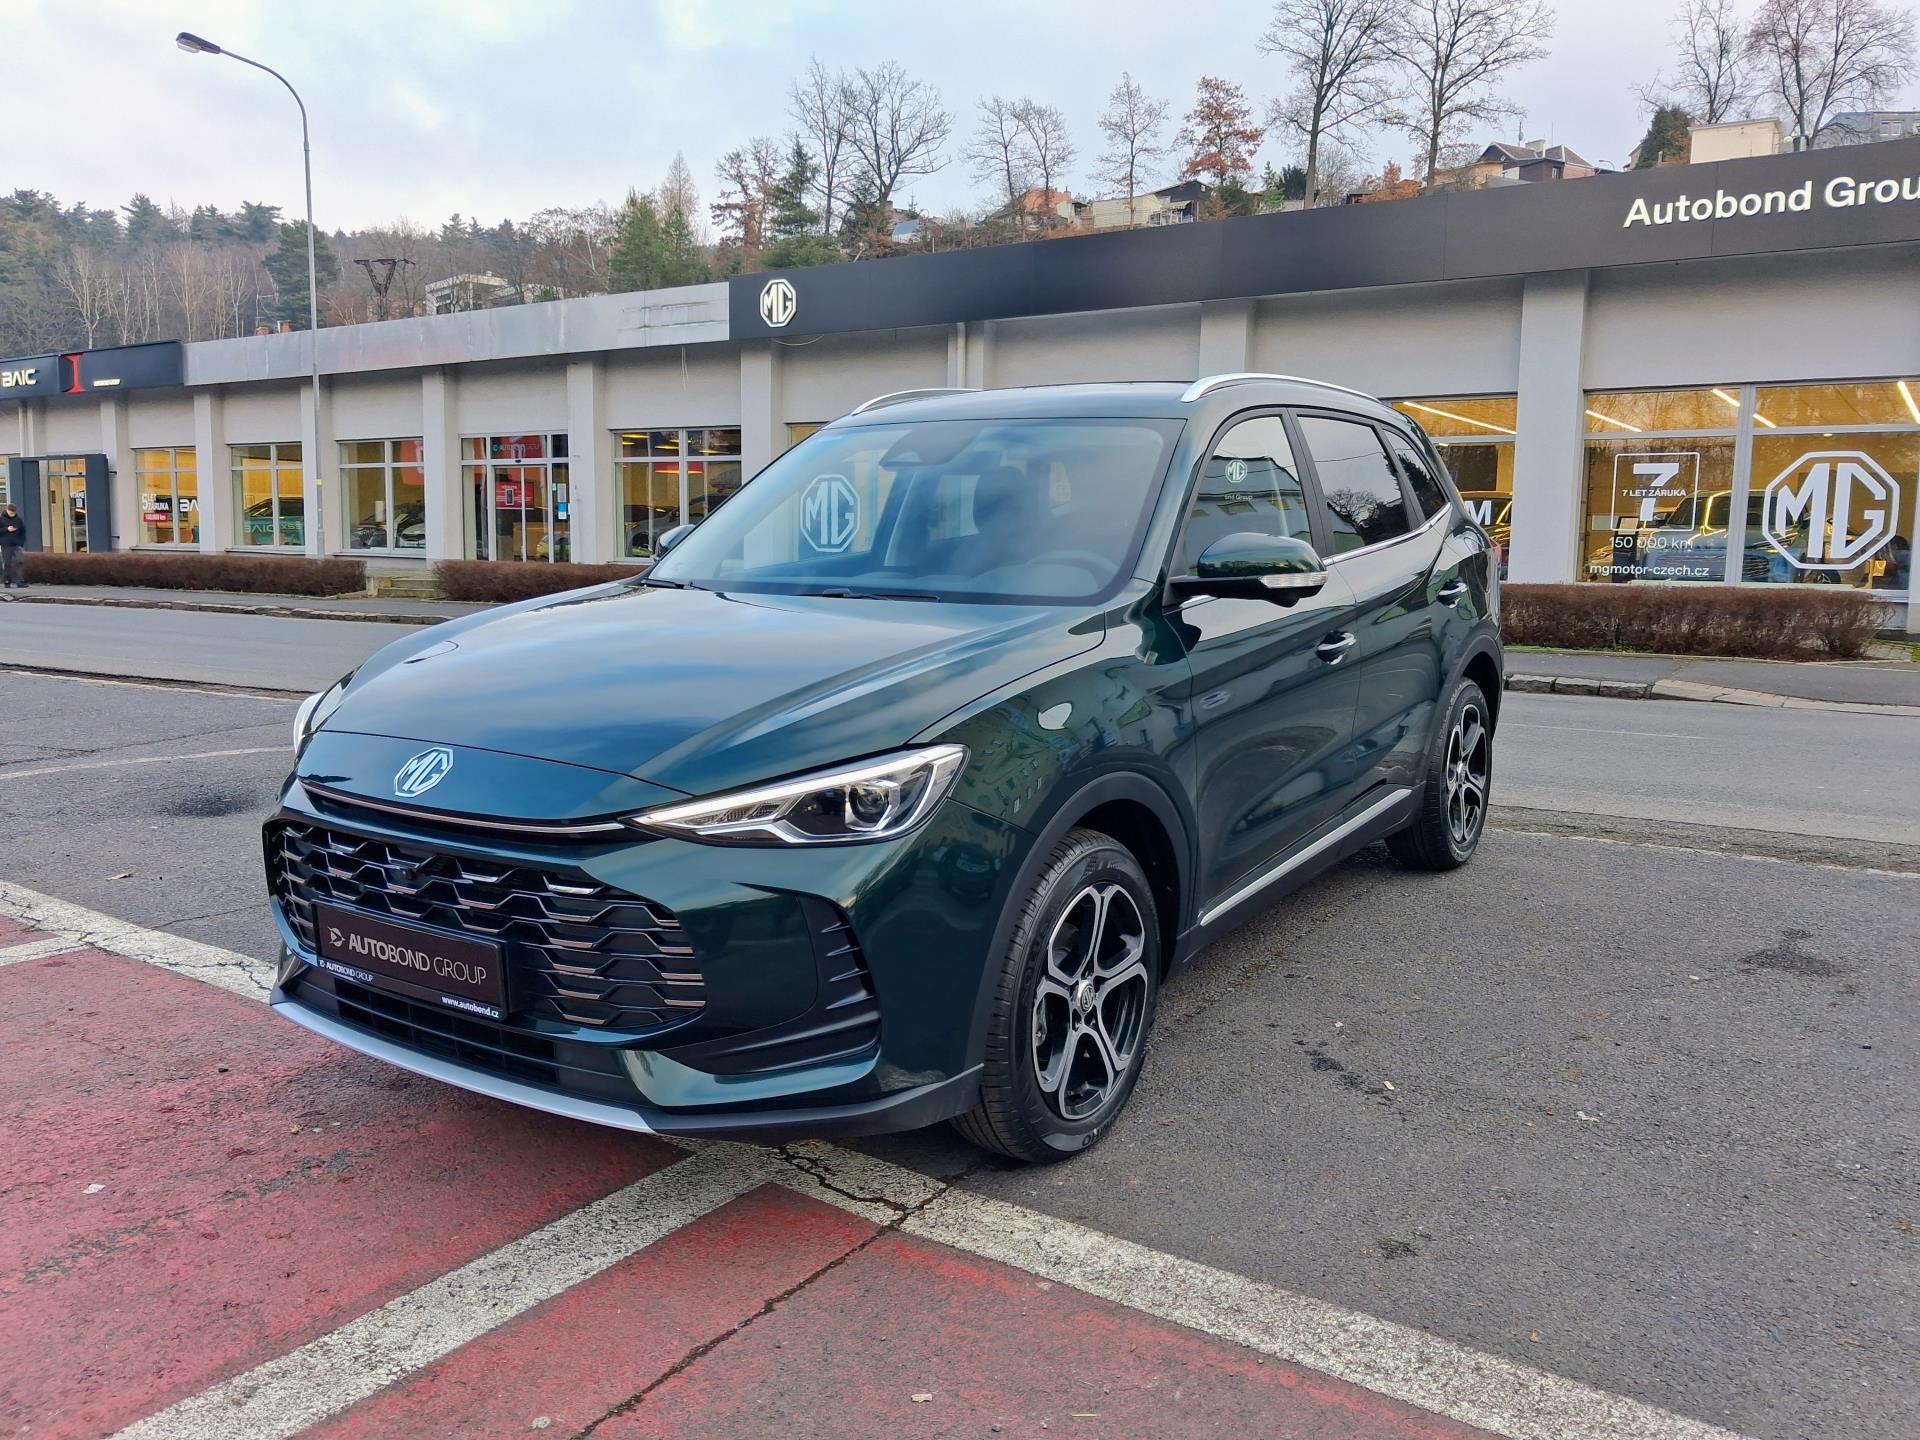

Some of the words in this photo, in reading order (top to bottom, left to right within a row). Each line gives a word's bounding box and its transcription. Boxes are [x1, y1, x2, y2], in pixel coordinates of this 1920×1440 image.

[1623, 180, 1813, 228] Autobond
[763, 283, 793, 323] MG
[1, 368, 37, 388] BAIC
[1227, 461, 1245, 481] MG
[1629, 489, 1647, 497] LET
[1649, 487, 1687, 497] ZÁRUKA
[1632, 462, 1680, 521] 7
[805, 480, 855, 545] MG
[1775, 462, 1887, 559] MG
[1609, 536, 1633, 549] 150
[1637, 536, 1667, 549] 000
[1671, 536, 1693, 549] km
[1589, 564, 1709, 576] mgmotor-czech.cz
[400, 751, 448, 792] MG
[326, 961, 356, 977] AUTOBOND
[348, 933, 431, 972] AUTOBOND
[433, 957, 487, 985] GROUP
[441, 996, 499, 1018] www.autobond.cz
